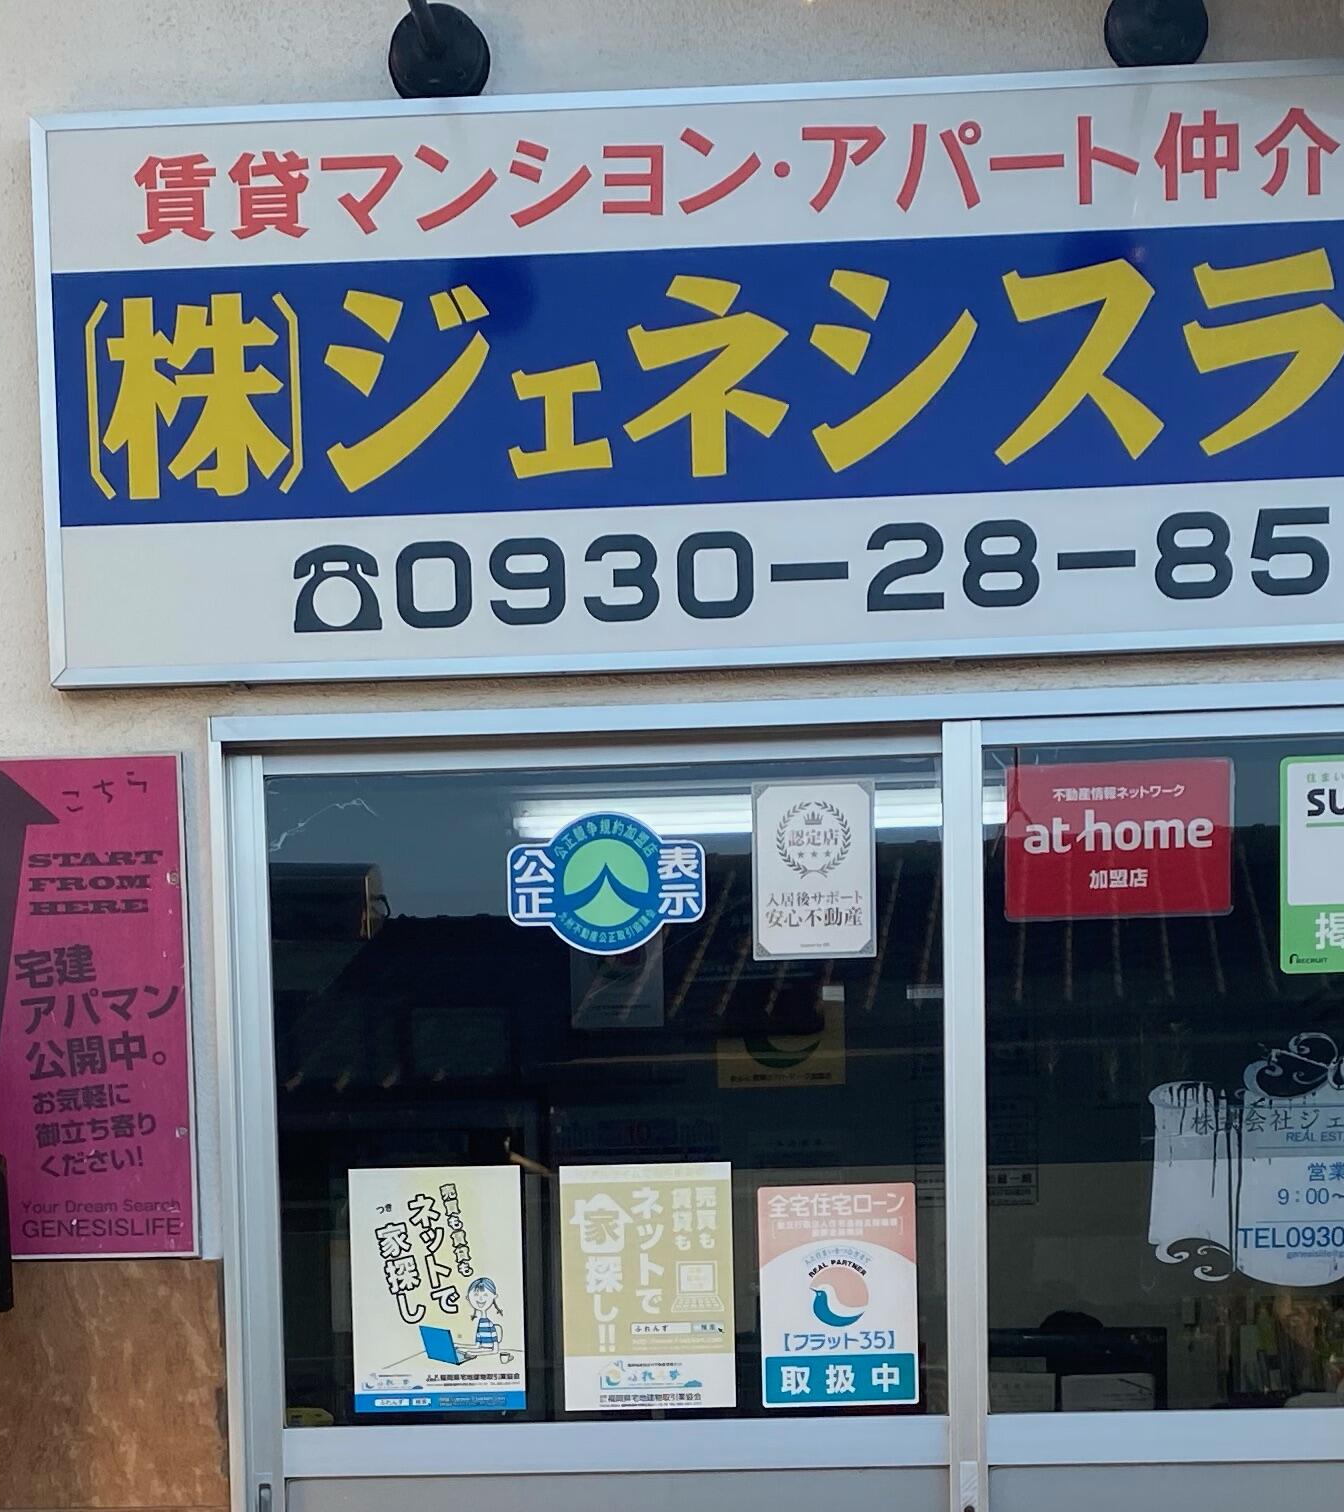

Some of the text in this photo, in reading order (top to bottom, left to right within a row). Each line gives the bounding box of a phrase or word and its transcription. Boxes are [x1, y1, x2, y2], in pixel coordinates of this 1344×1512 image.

[61, 770, 148, 813] こちら
[1052, 784, 1185, 802] 不動産情報ネットワーク
[787, 828, 840, 848] 認定店
[1023, 809, 1214, 855] at home
[27, 849, 164, 869] START
[28, 874, 152, 893] FROM
[512, 848, 557, 920] 公正
[656, 845, 700, 917] 表示
[1088, 868, 1149, 890] 加盟店
[29, 898, 149, 916] HERE
[766, 889, 864, 908] 入居後サポート
[764, 906, 864, 929] 安心不動産
[14, 943, 97, 989] 宅建
[20, 985, 179, 1035] アパマン
[25, 1030, 167, 1081] 公開中。
[31, 1083, 131, 1115] お気軽に
[34, 1111, 157, 1149] 御立ち寄り
[1285, 1131, 1319, 1142] REAL
[40, 1145, 144, 1178] ください!
[21, 1197, 181, 1215] Your Dream Search
[671, 1187, 693, 1251] 賃貸も
[694, 1186, 717, 1249] 売買も
[767, 1192, 906, 1219] 全宅住宅ローン
[21, 1217, 182, 1239] GENESISLIFE
[438, 1182, 474, 1278] 売買も賃貸も
[407, 1193, 461, 1315] ネットで
[630, 1186, 665, 1315] ネットで
[374, 1221, 427, 1325] 家探し
[808, 1258, 868, 1279] REAL PARTNER
[780, 1362, 900, 1396] 取扱中
